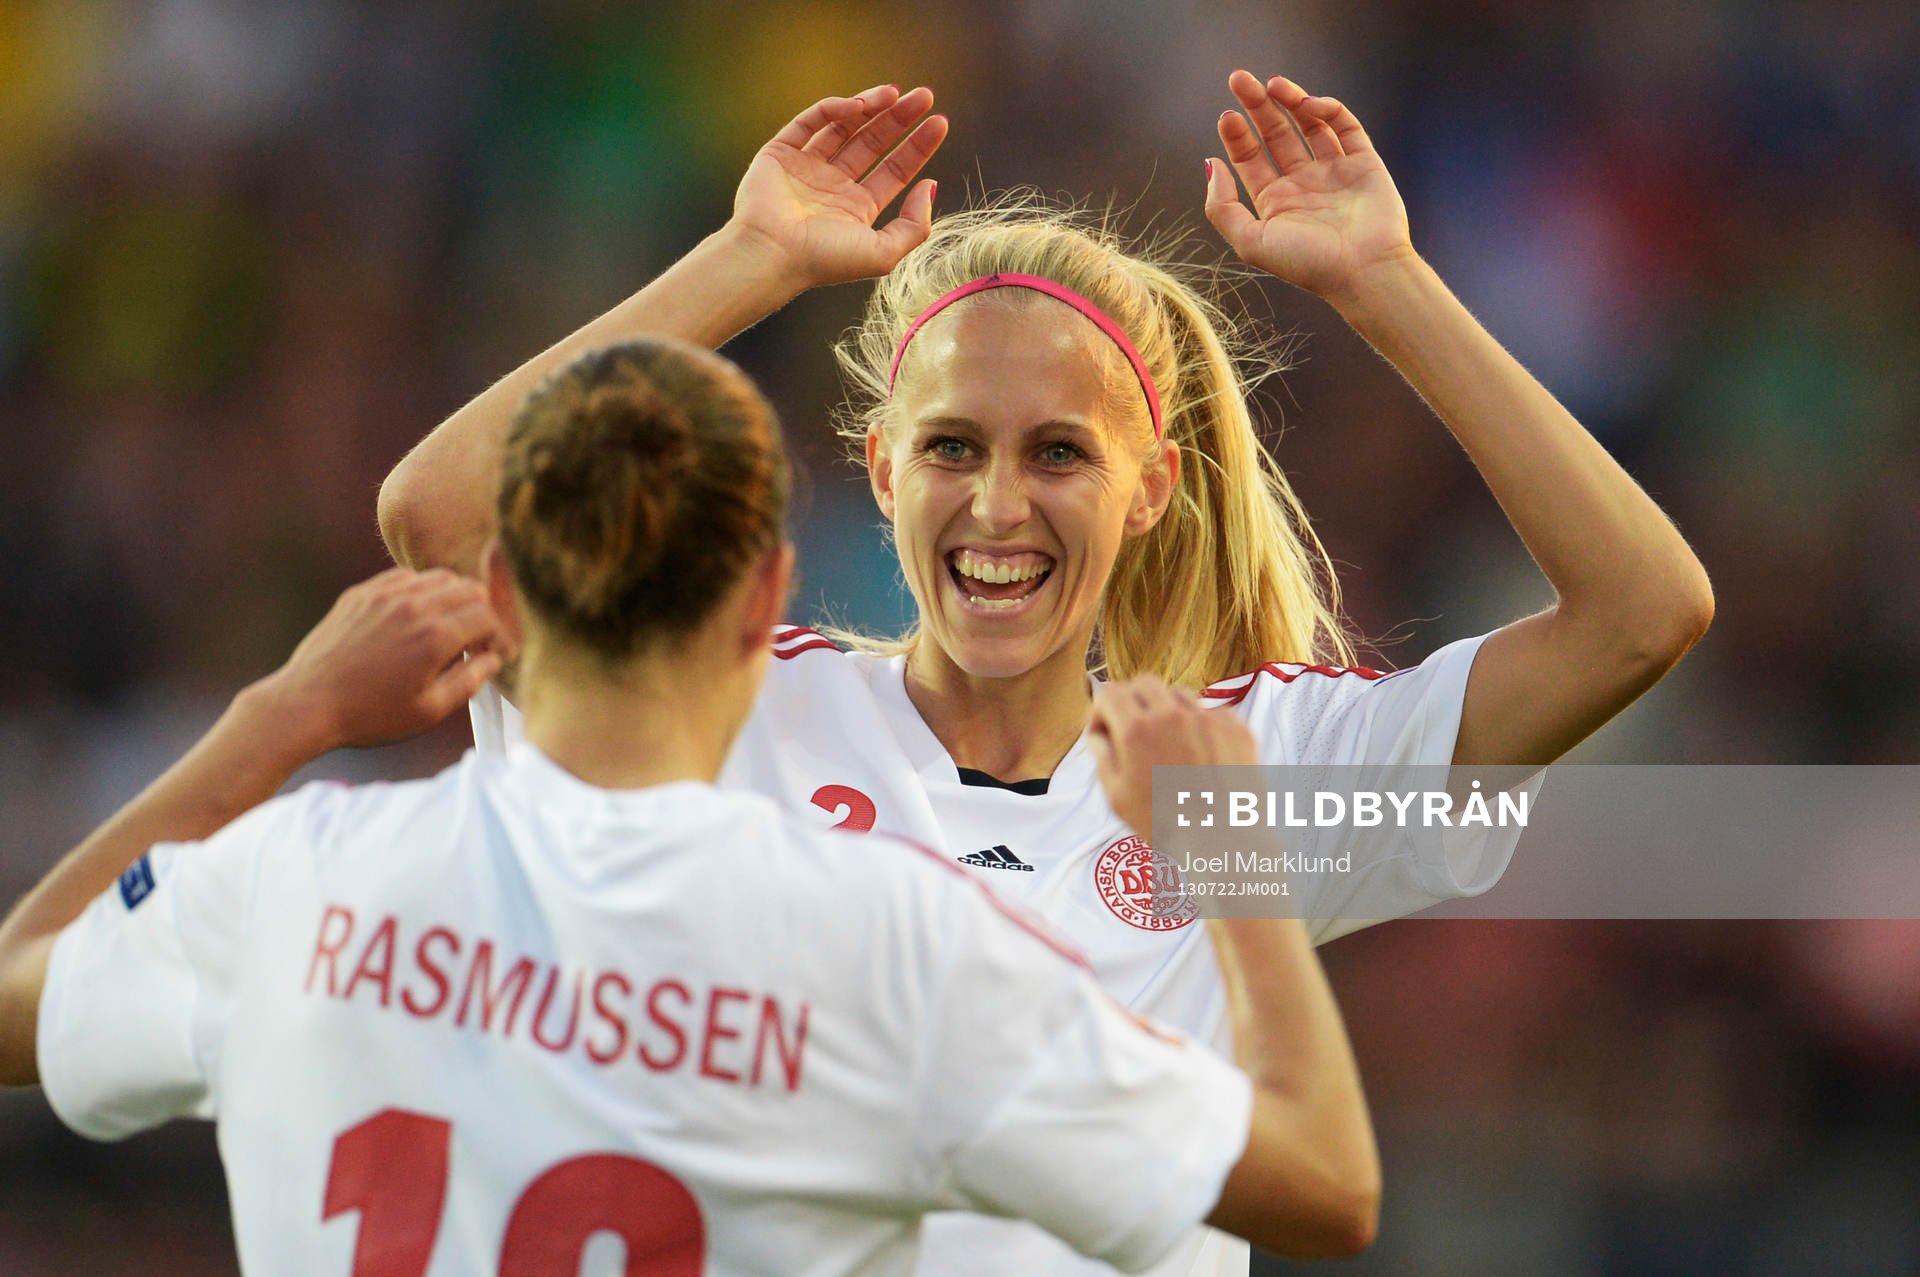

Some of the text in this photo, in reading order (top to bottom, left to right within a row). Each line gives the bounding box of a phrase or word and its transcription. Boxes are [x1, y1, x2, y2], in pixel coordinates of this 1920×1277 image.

[957, 856, 1035, 872] adidas
[1119, 864, 1180, 895] DBU
[1100, 865, 1135, 920] DANSK
[1141, 912, 1184, 929] 1889
[305, 903, 810, 1092] RASMUSSEN
